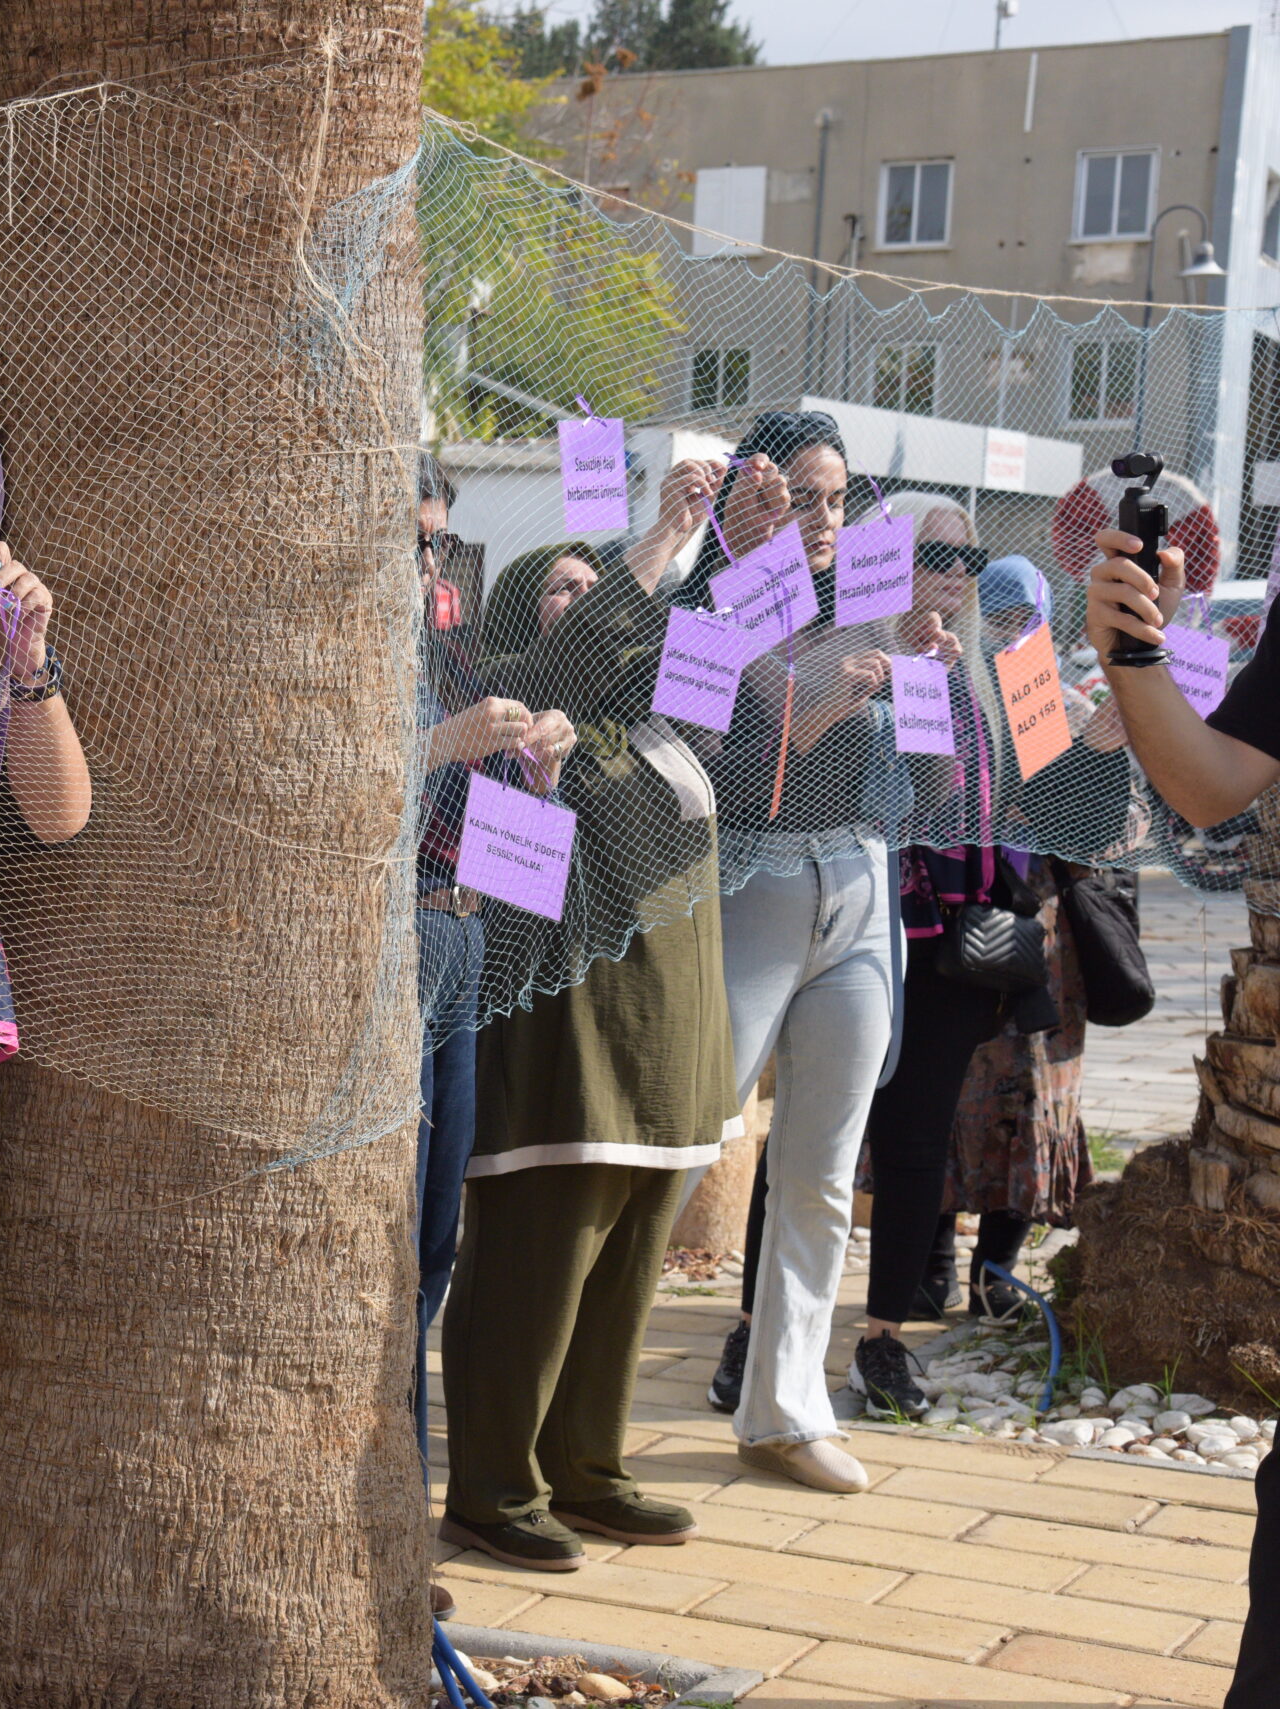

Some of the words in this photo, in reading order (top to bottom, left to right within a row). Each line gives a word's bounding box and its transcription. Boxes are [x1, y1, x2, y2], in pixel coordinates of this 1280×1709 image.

[851, 553, 878, 570] Kadına
[1010, 684, 1031, 707] ALO
[1033, 668, 1052, 690] 183
[1016, 714, 1037, 737] ALO
[1039, 699, 1057, 720] 155
[469, 816, 498, 836] KADINA
[499, 828, 533, 850] YÖNELİK
[533, 842, 567, 863] ŞİDDETE
[486, 843, 514, 861] SESSİZ
